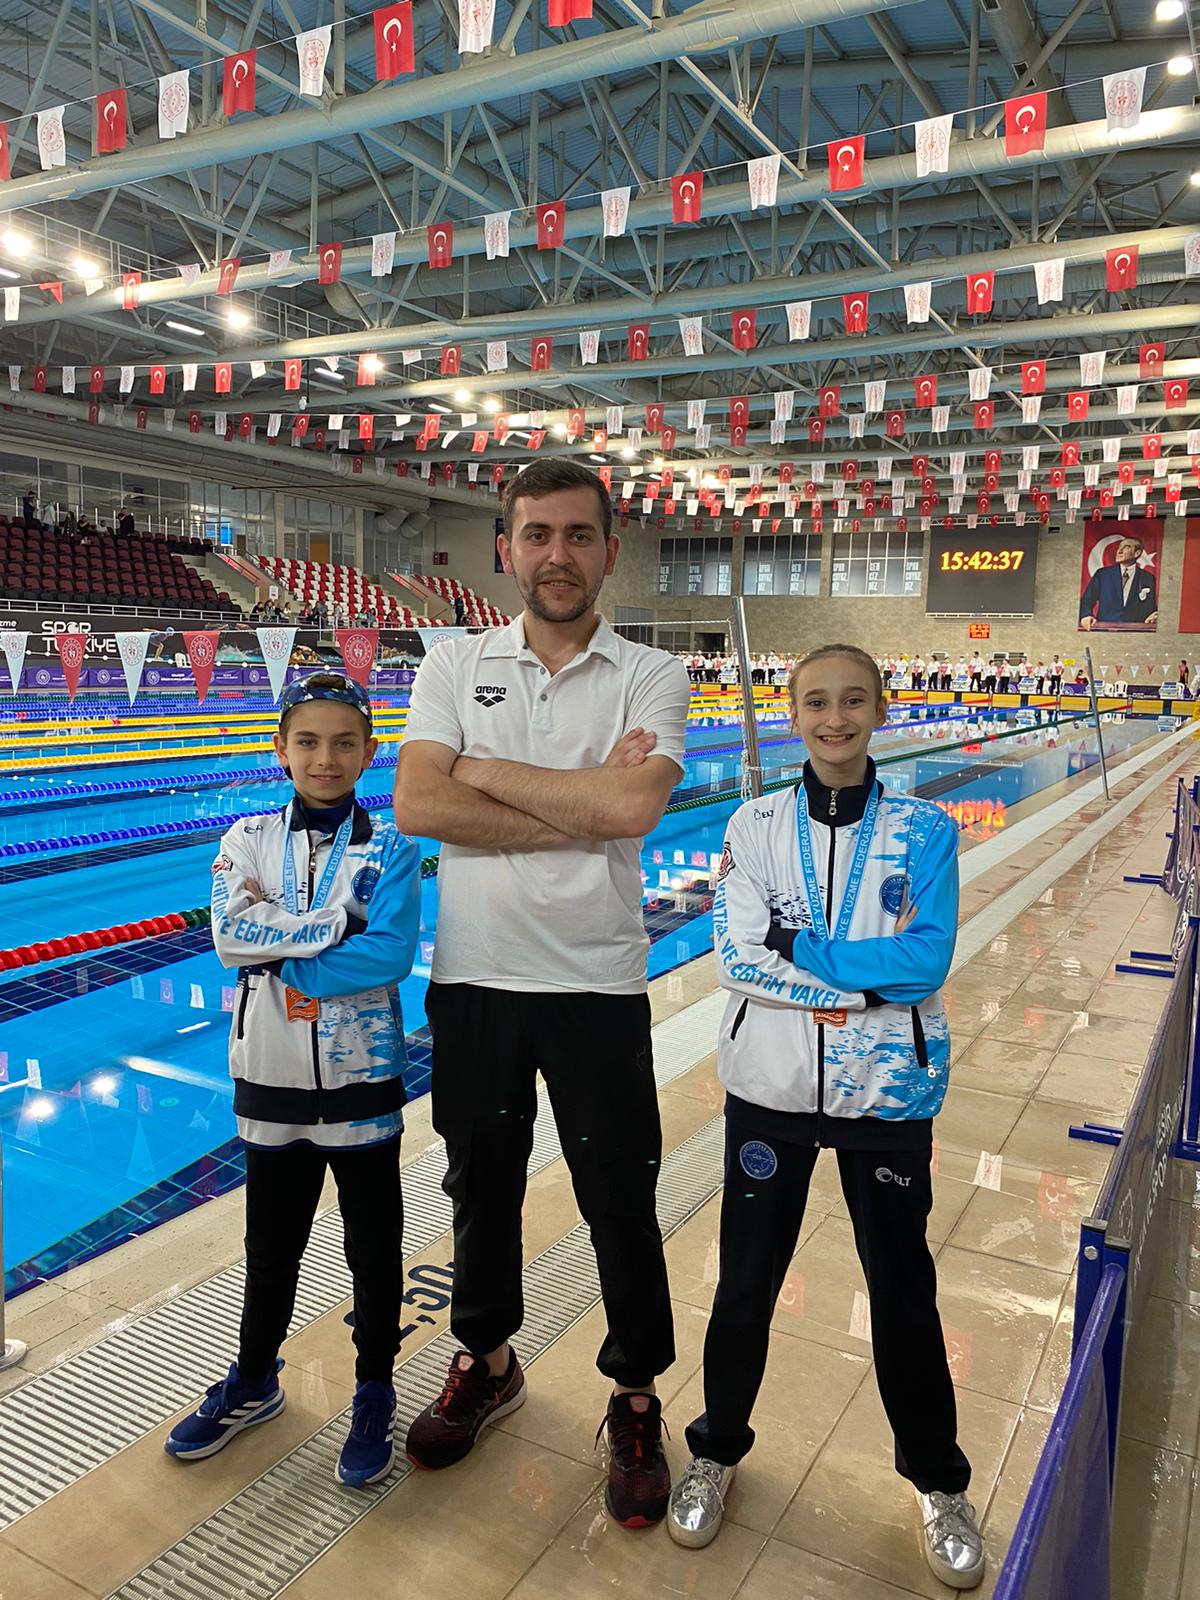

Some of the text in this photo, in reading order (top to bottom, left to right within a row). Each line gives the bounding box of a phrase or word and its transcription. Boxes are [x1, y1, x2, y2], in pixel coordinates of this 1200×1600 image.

[941, 551, 1024, 570] 15:42:37
[475, 685, 507, 695] arena
[852, 797, 879, 876] FEDERASYONU
[721, 938, 739, 966] VE
[789, 982, 840, 1009] VAKFI
